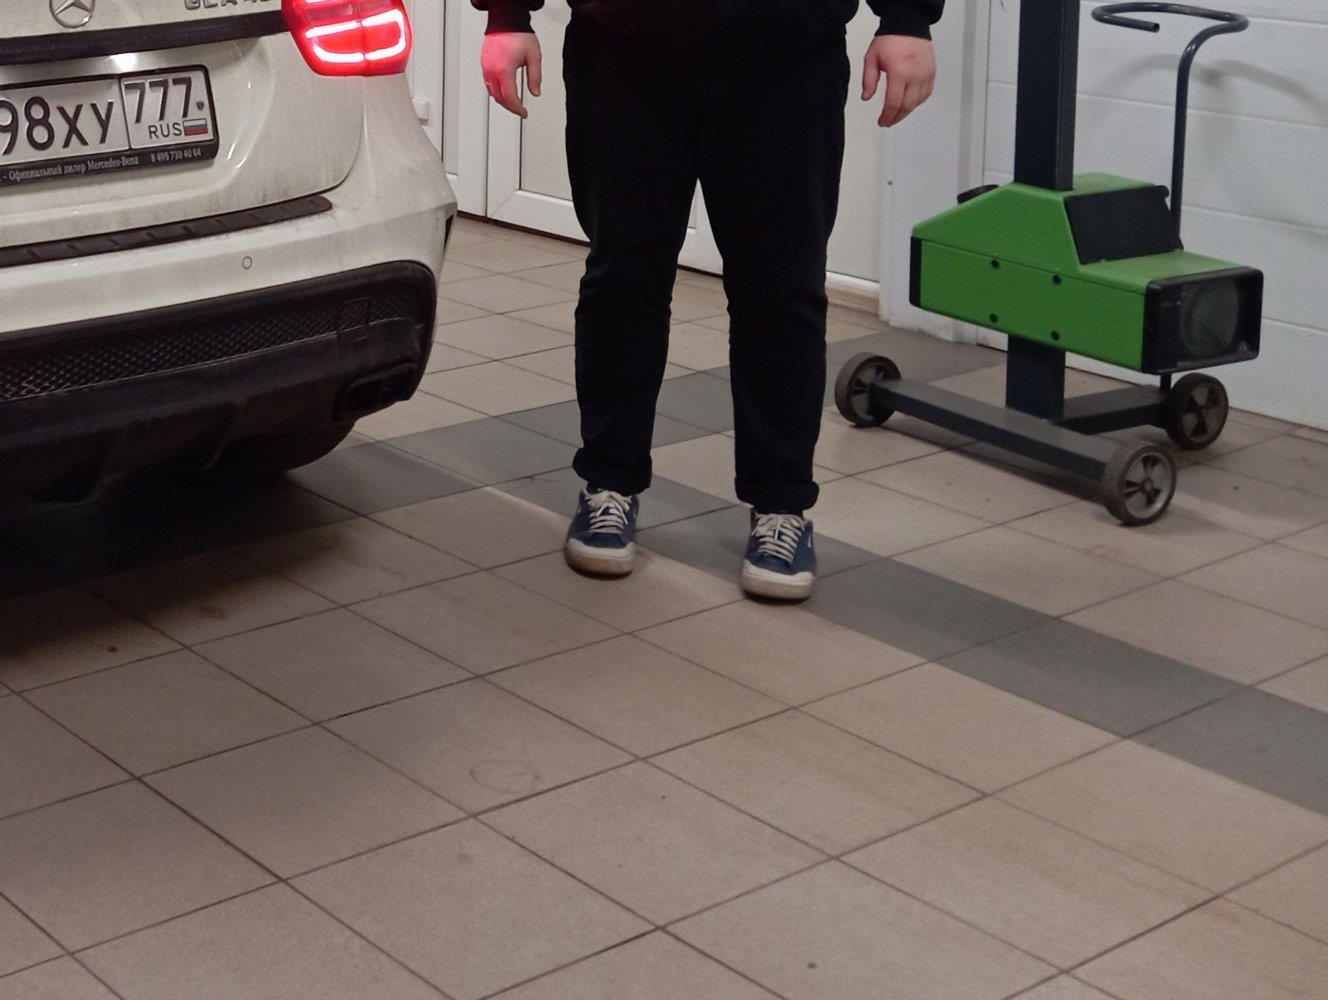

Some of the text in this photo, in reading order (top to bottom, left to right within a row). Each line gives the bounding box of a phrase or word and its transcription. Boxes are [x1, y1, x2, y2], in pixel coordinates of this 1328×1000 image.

[124, 76, 192, 124] 777
[148, 121, 183, 139] RUS
[87, 154, 139, 171] Mercedes-Benz
